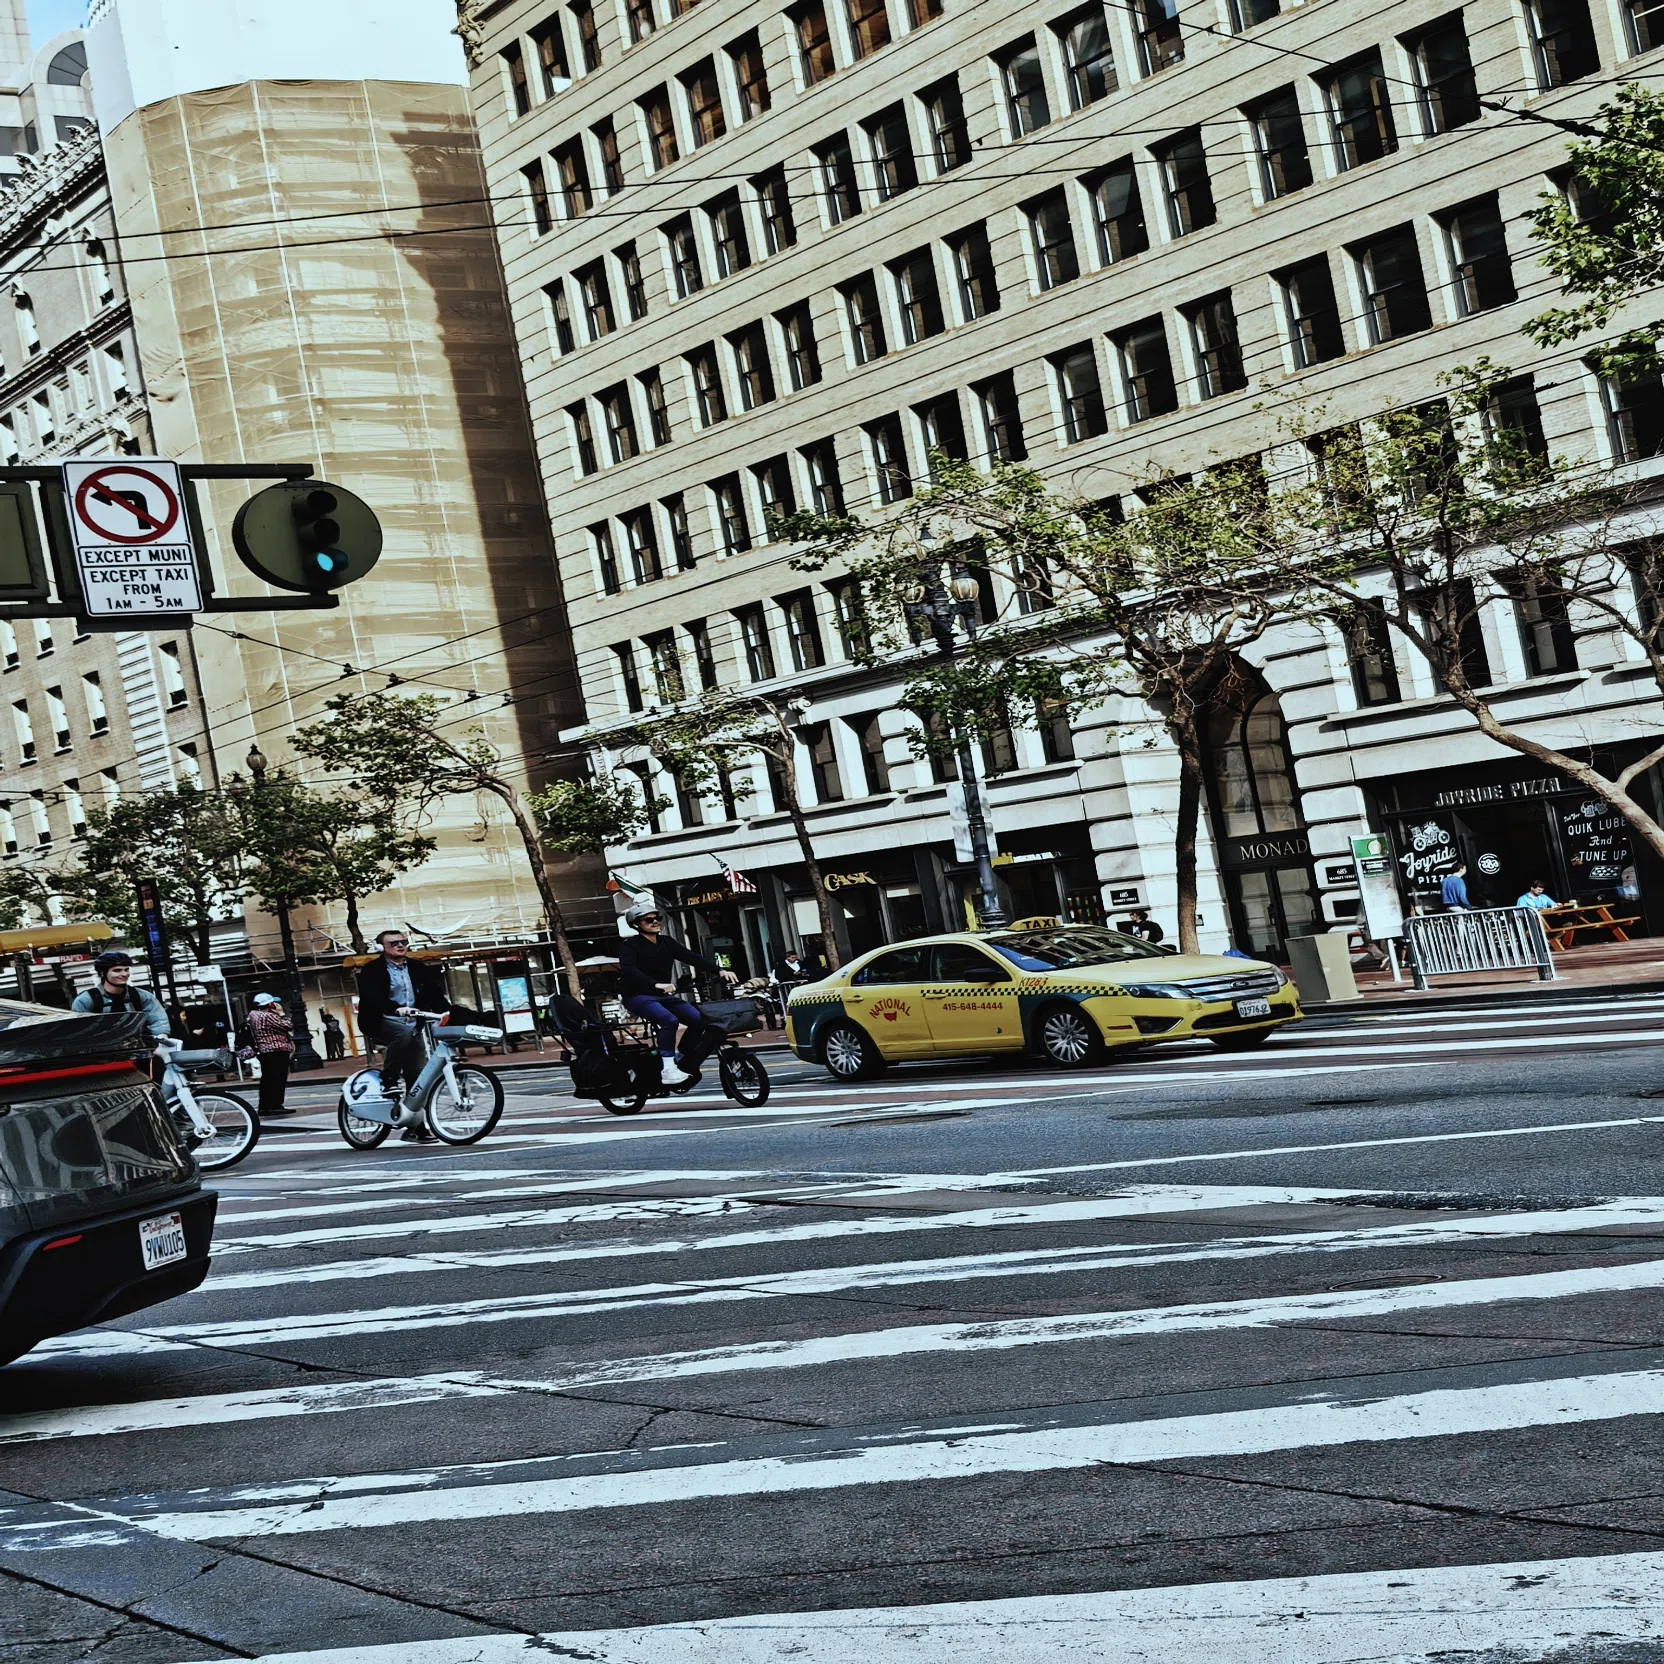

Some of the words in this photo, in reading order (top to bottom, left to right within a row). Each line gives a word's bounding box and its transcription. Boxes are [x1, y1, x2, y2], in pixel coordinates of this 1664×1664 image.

[84, 550, 142, 564] EXCEPT
[148, 549, 188, 562] MUNI
[90, 569, 147, 583] EXCEPT
[155, 568, 189, 581] TAXI
[123, 583, 162, 595] FROM
[106, 597, 133, 610] 1AM
[154, 595, 184, 608] 5AM
[1434, 784, 1504, 807] JOYRIDE
[1508, 776, 1561, 798] PIZZA
[1567, 821, 1594, 836] QUIK
[1599, 816, 1628, 831] LUBE
[1588, 834, 1613, 847] And
[1398, 846, 1458, 879] Joyride
[1579, 850, 1608, 862] TUNE
[1613, 849, 1628, 861] UP
[823, 871, 877, 892] CASK
[1417, 873, 1453, 885] PIZZ
[1022, 918, 1058, 930] TAXI
[869, 998, 912, 1019] NATIONAL
[942, 1001, 1004, 1012] 415-648-4444
